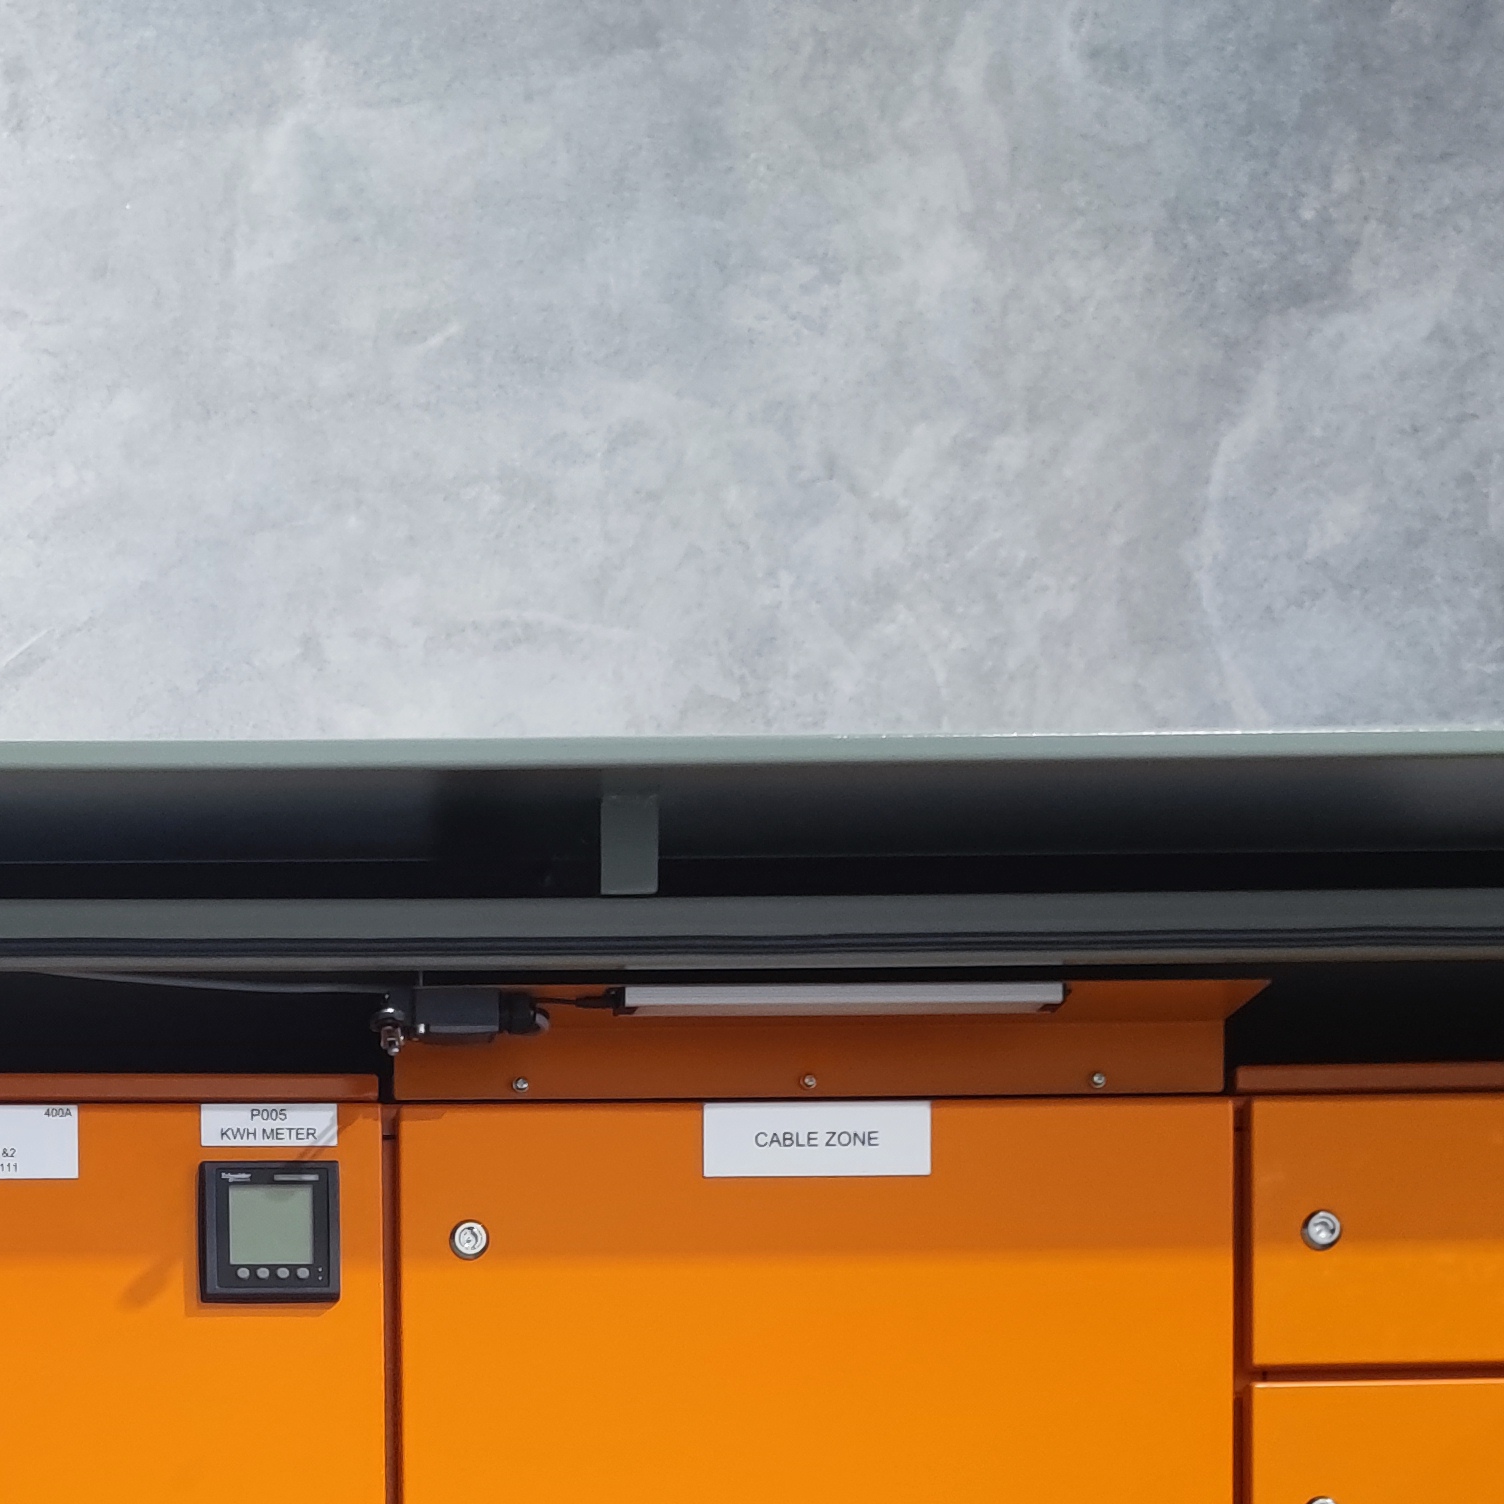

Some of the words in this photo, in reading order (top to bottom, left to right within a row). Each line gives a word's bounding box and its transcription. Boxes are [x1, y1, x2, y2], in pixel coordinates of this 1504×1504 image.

[43, 1108, 73, 1118] 400A
[250, 1109, 288, 1121] P005
[220, 1127, 257, 1141] KWH
[261, 1127, 318, 1141] METER
[754, 1131, 819, 1148] CABLE
[825, 1130, 880, 1147] ZONE
